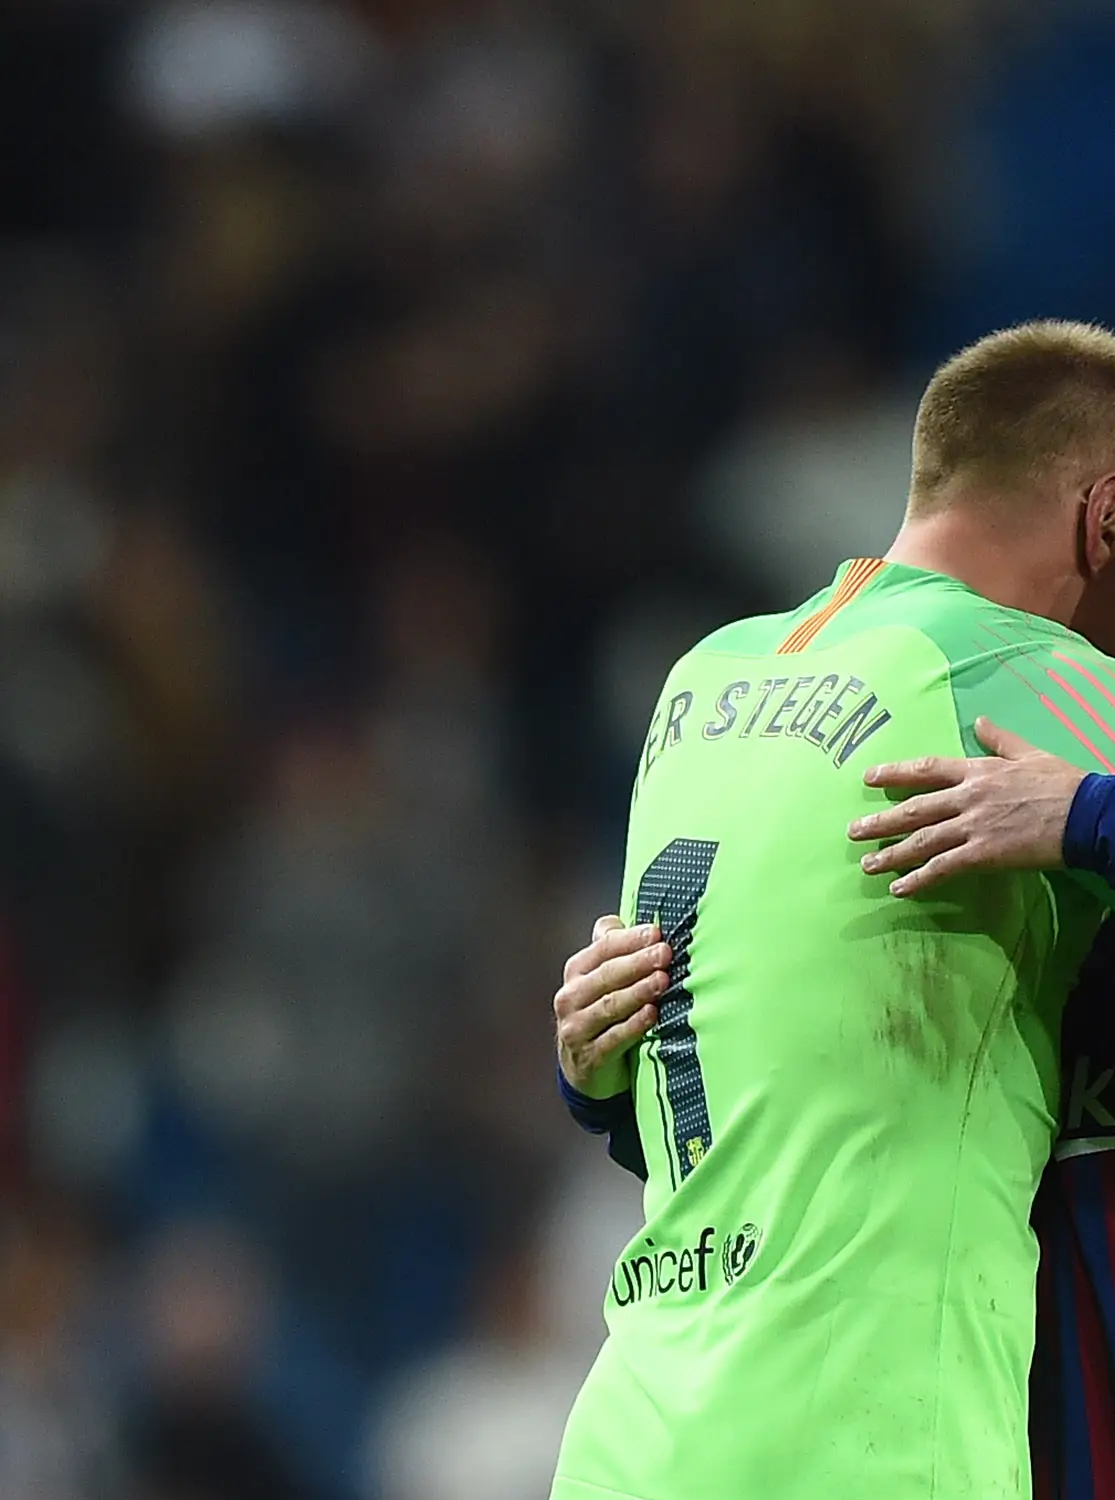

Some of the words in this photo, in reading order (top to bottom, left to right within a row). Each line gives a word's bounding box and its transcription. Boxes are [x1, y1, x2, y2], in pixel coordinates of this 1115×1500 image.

[638, 690, 694, 788] ER
[701, 673, 892, 769] STEGEN
[636, 837, 720, 1192] 1
[612, 1226, 716, 1308] unicef
